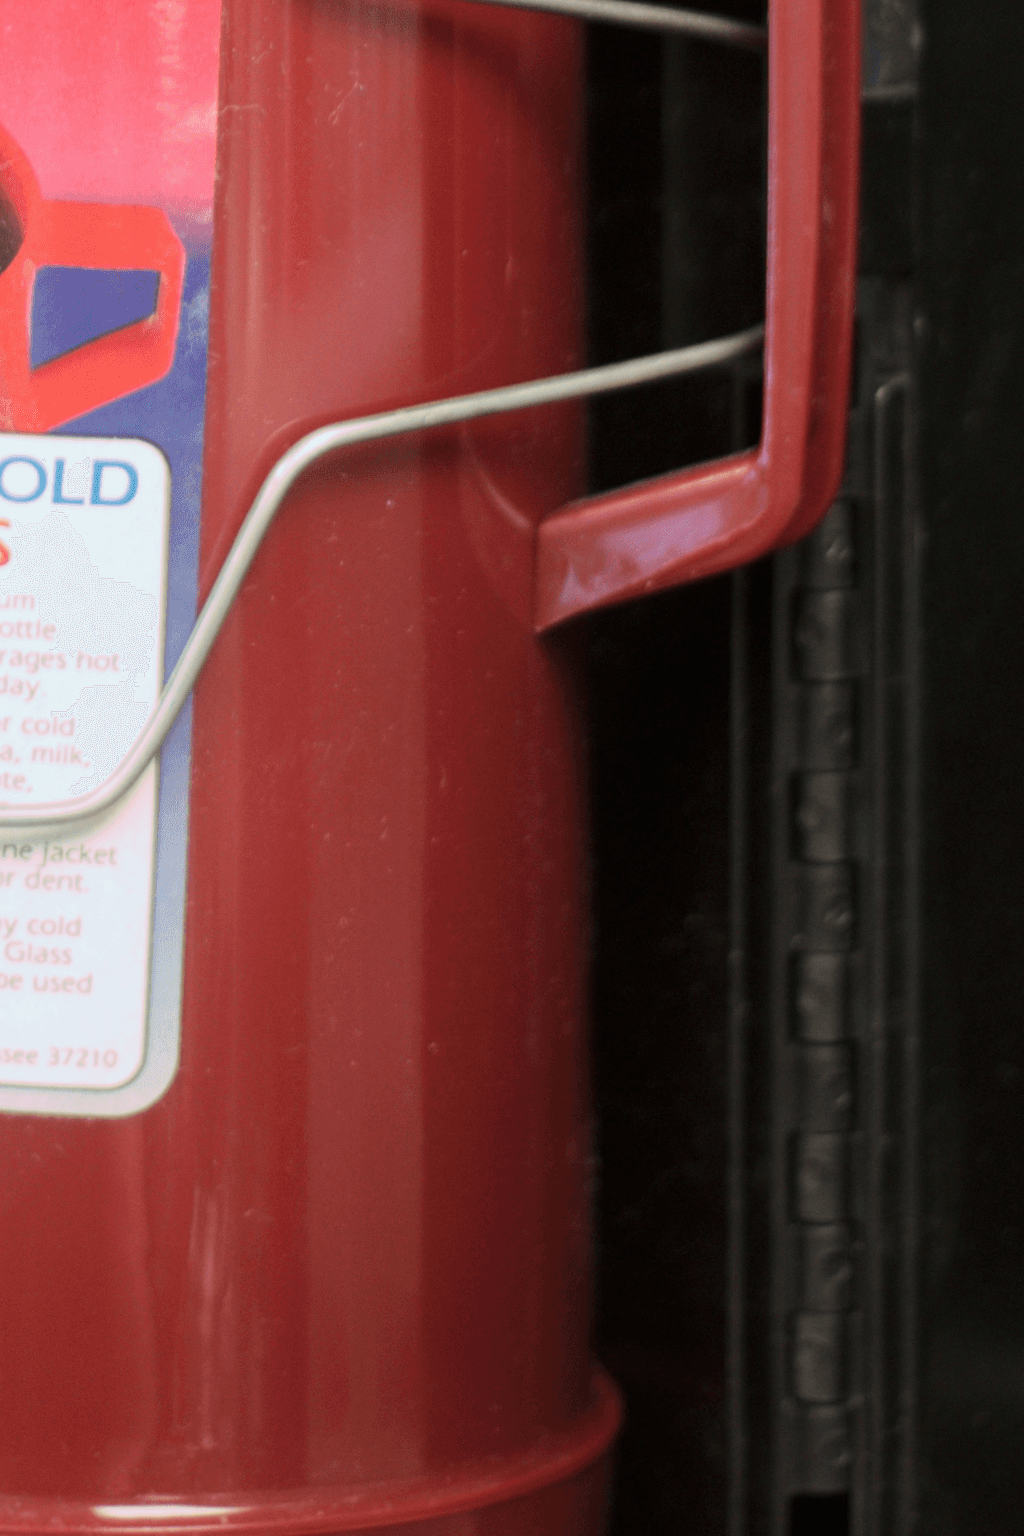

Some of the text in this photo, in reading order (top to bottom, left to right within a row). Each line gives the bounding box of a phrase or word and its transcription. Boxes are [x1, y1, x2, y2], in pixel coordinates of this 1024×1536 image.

[76, 649, 121, 672] hot
[21, 716, 76, 737] cold
[31, 743, 92, 769] milk,
[40, 841, 118, 867] jacket
[24, 869, 89, 893] dent.
[26, 915, 83, 937] cold
[3, 940, 73, 966] Glass
[32, 972, 94, 996] used
[46, 1044, 119, 1069] 37210
